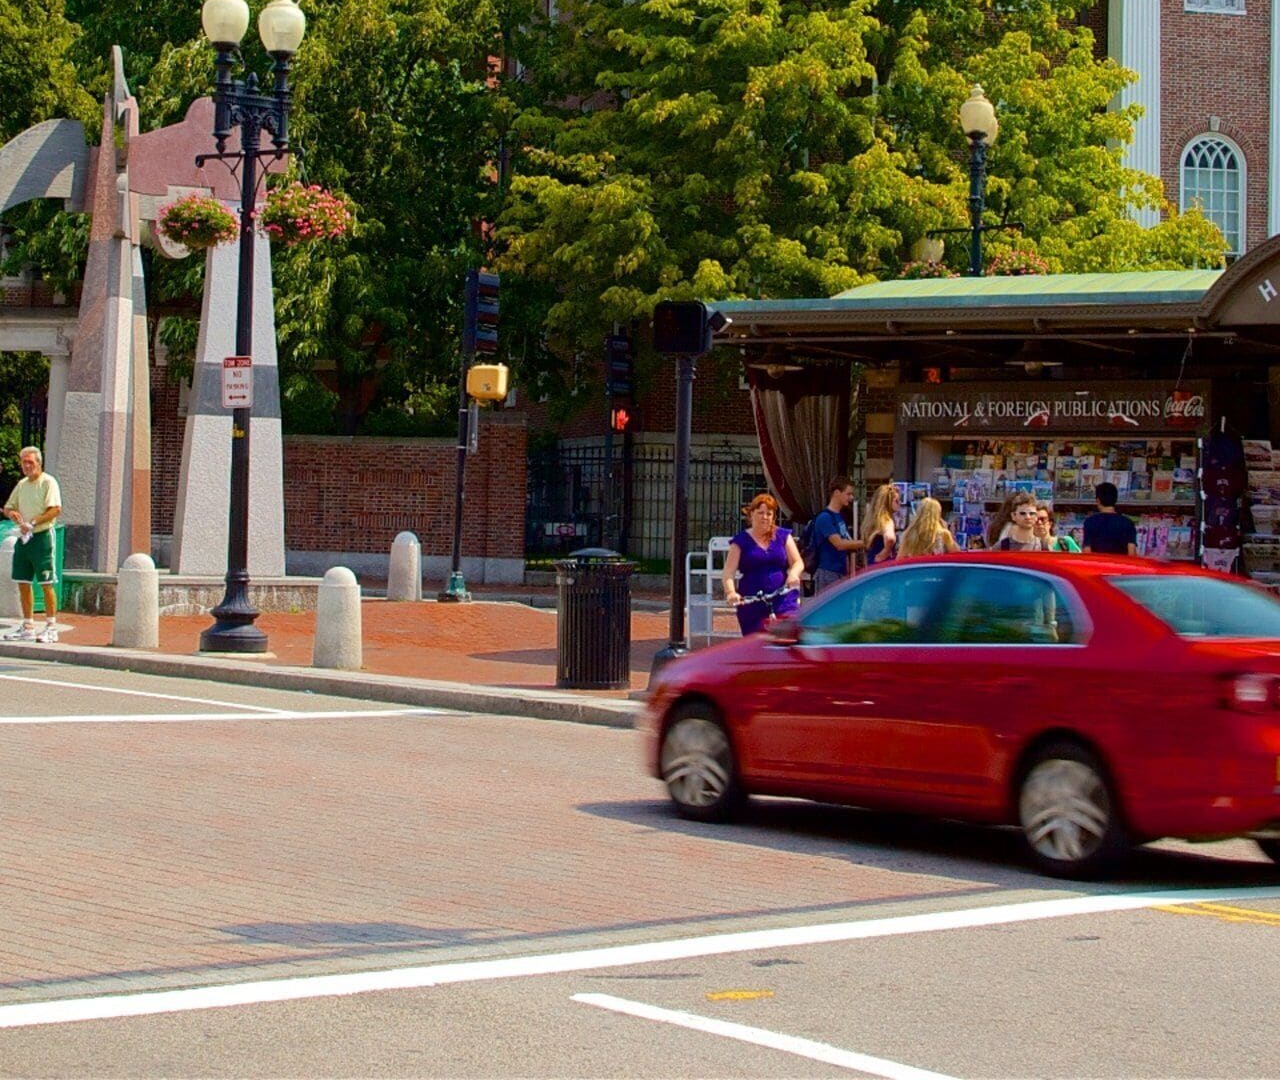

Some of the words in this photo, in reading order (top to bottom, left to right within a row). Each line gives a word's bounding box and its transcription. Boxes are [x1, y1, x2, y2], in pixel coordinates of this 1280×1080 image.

[901, 401, 971, 418] NATIONAL
[973, 402, 985, 417] &
[987, 400, 1051, 417] FOREIGN
[1054, 399, 1160, 417] PUBLICATIONS
